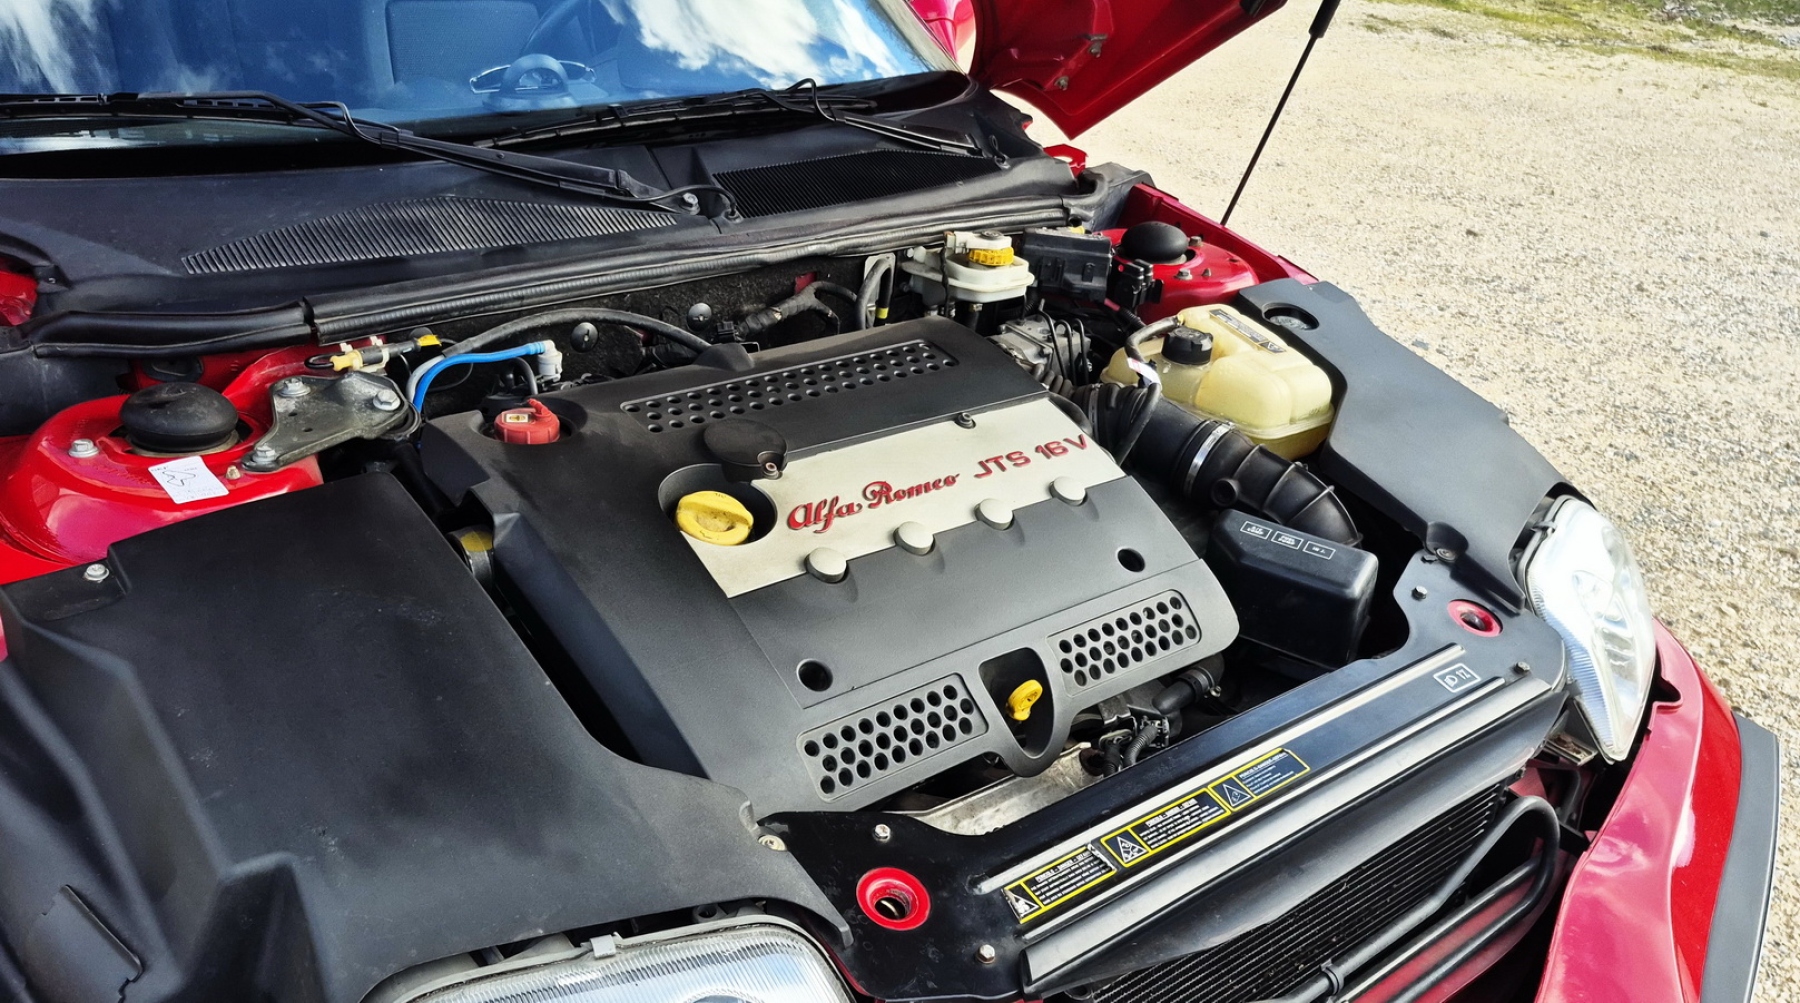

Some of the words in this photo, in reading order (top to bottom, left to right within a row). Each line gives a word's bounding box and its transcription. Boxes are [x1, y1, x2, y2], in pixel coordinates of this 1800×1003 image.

[787, 495, 863, 534] Alfa
[862, 473, 960, 509] Romeo
[974, 450, 1032, 478] JTS
